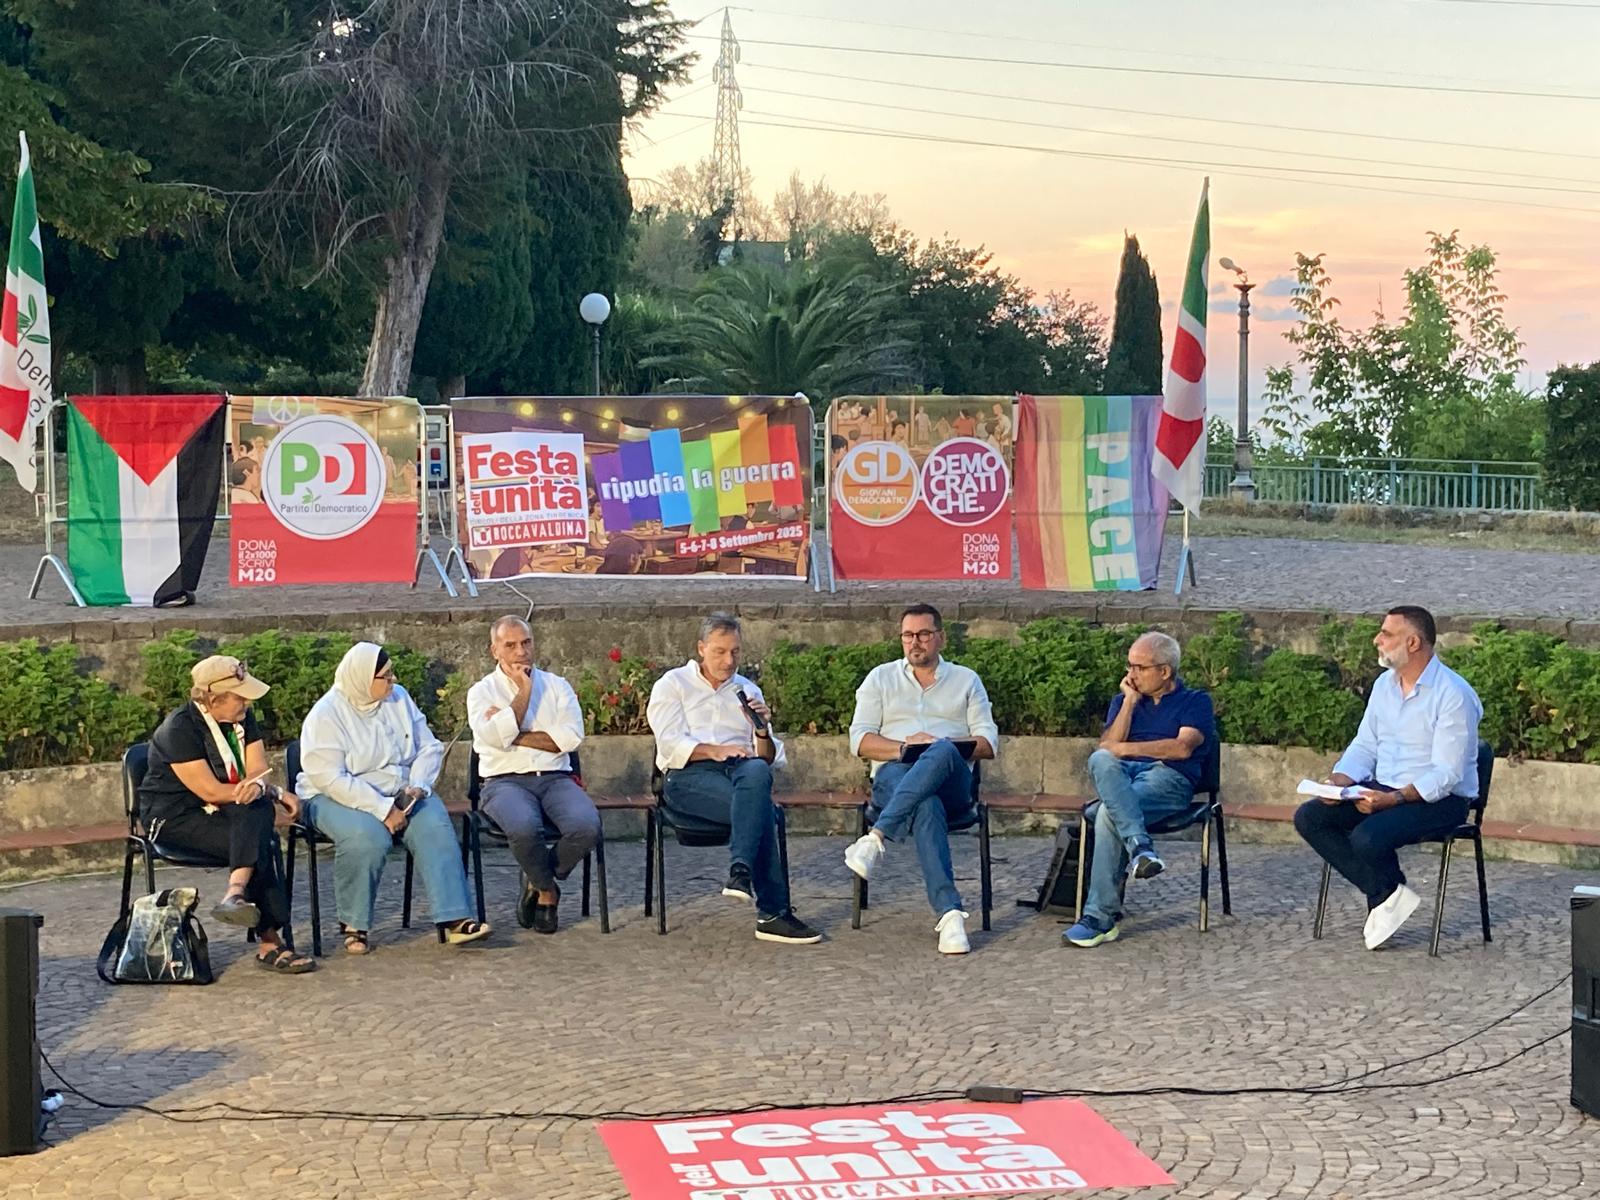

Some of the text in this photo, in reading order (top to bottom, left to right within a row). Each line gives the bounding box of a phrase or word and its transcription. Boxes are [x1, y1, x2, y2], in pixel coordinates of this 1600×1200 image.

[467, 444, 578, 479] Festa
[847, 447, 910, 484] GD
[930, 452, 1002, 477] DEMO
[601, 460, 796, 503] ripudia la guerra
[859, 488, 897, 496] GIOVANI
[930, 472, 997, 496] CRATI
[480, 475, 583, 515] unità
[848, 496, 907, 505] DEMOCRATICI
[1086, 431, 1138, 582] PACE
[280, 503, 368, 513] Partito Democratico
[238, 539, 277, 550] DONA
[719, 531, 775, 549] Settembre
[776, 525, 804, 539] 2025
[963, 533, 1000, 544] DONA
[238, 560, 276, 568] SCRIVI
[963, 552, 999, 561] SCRIVI
[963, 561, 1000, 575] M20
[238, 568, 276, 582] M20
[652, 1110, 1026, 1155] Festa
[710, 1137, 1067, 1186] unità
[769, 1172, 1075, 1200] ROCCAVALDINA
